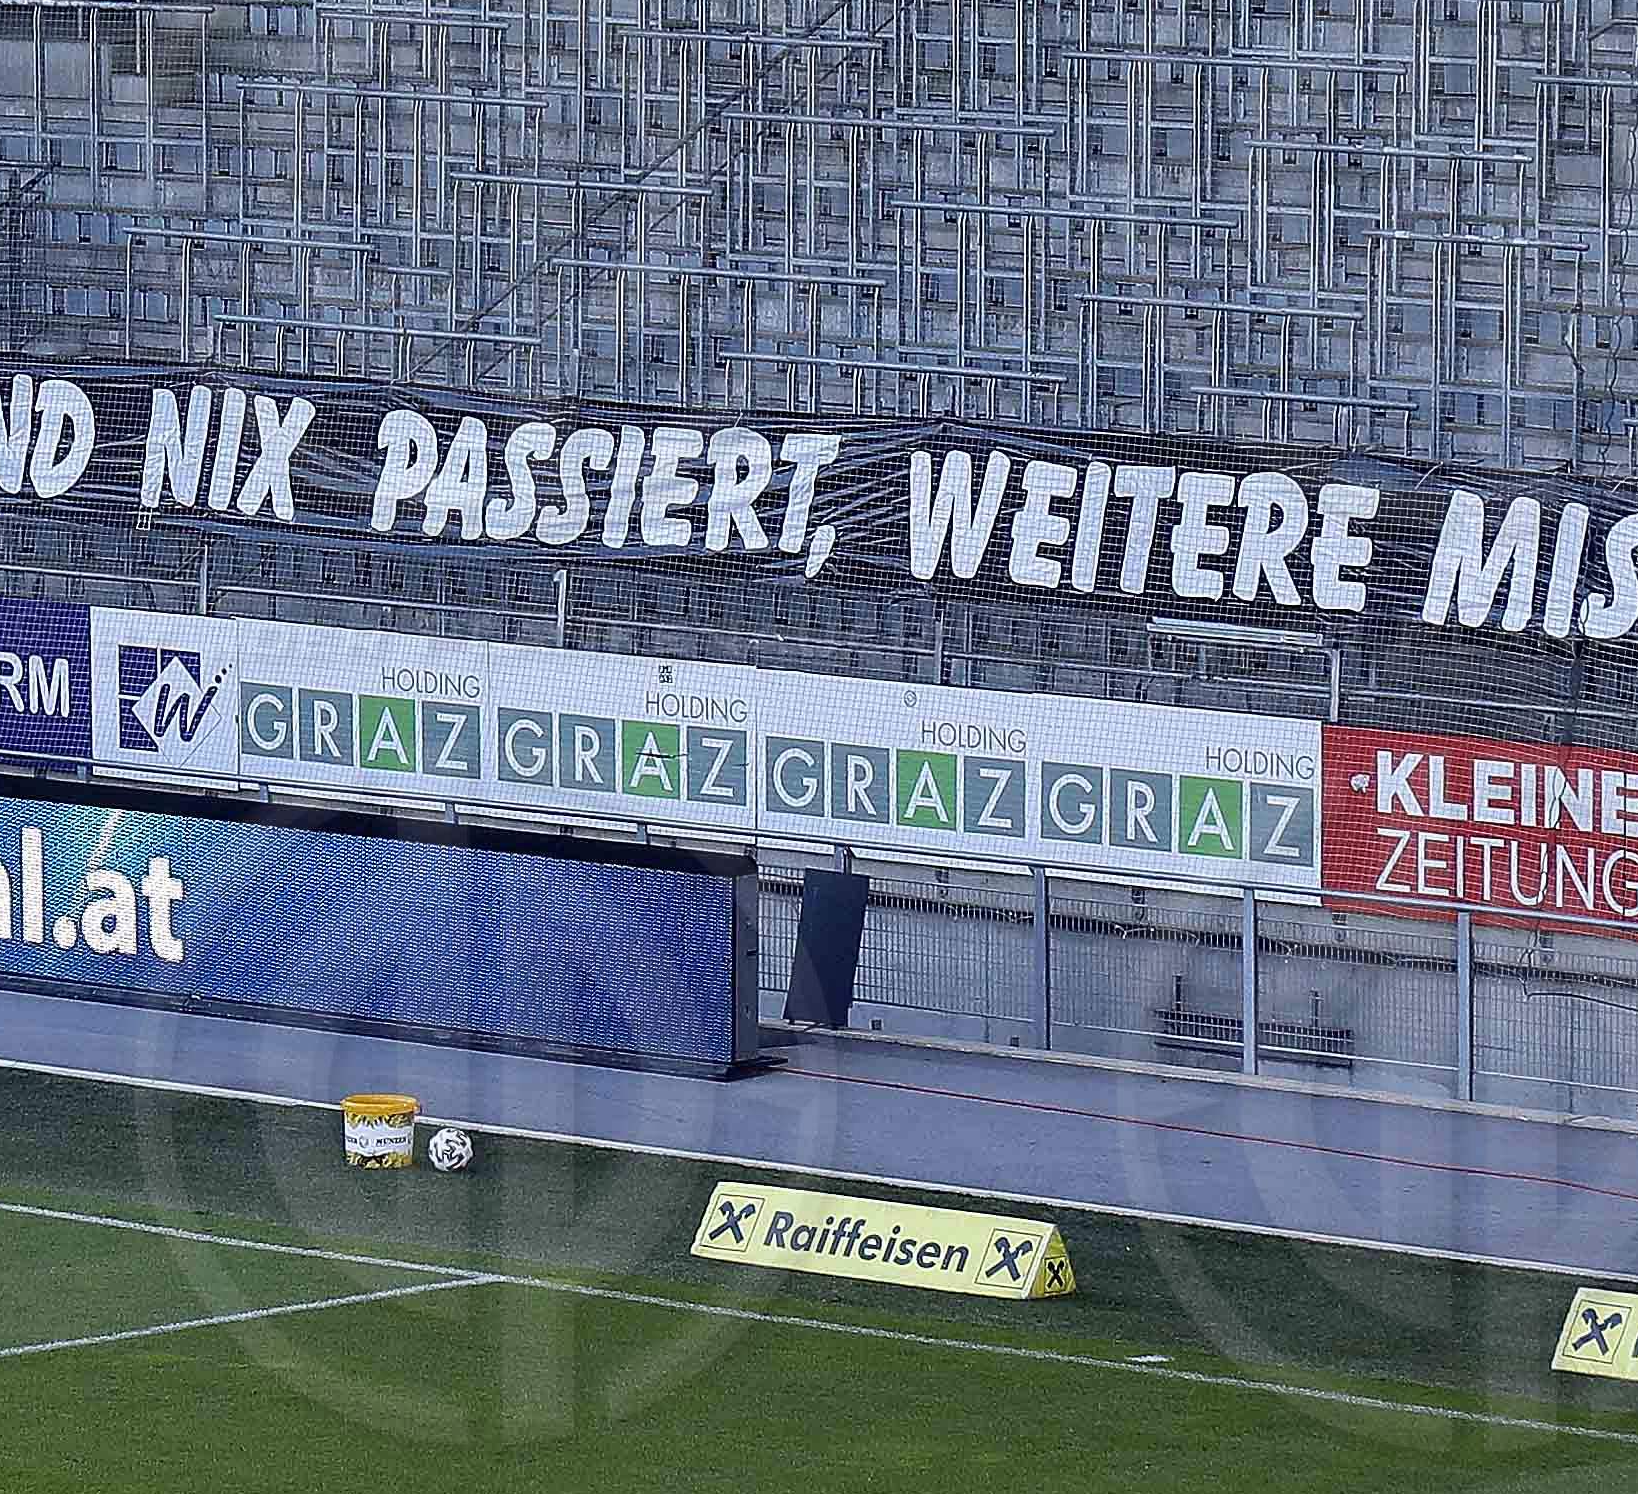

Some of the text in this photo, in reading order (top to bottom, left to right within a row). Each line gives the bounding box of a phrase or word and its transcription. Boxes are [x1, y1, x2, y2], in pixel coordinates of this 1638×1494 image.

[141, 386, 314, 521] NIX
[370, 408, 840, 579] PASSIERT,
[907, 447, 1379, 610] WEITERE
[381, 666, 480, 699] HOLDING
[646, 691, 748, 723] HOLDING
[246, 692, 470, 771] GRAZ
[504, 720, 734, 797] GRAZ
[921, 720, 1027, 754] HOLDING
[1205, 746, 1315, 779] HOLDING
[772, 747, 1013, 828] GRAZ
[1049, 773, 1301, 857] GRAZ
[763, 1209, 970, 1277] Raiffeisen
